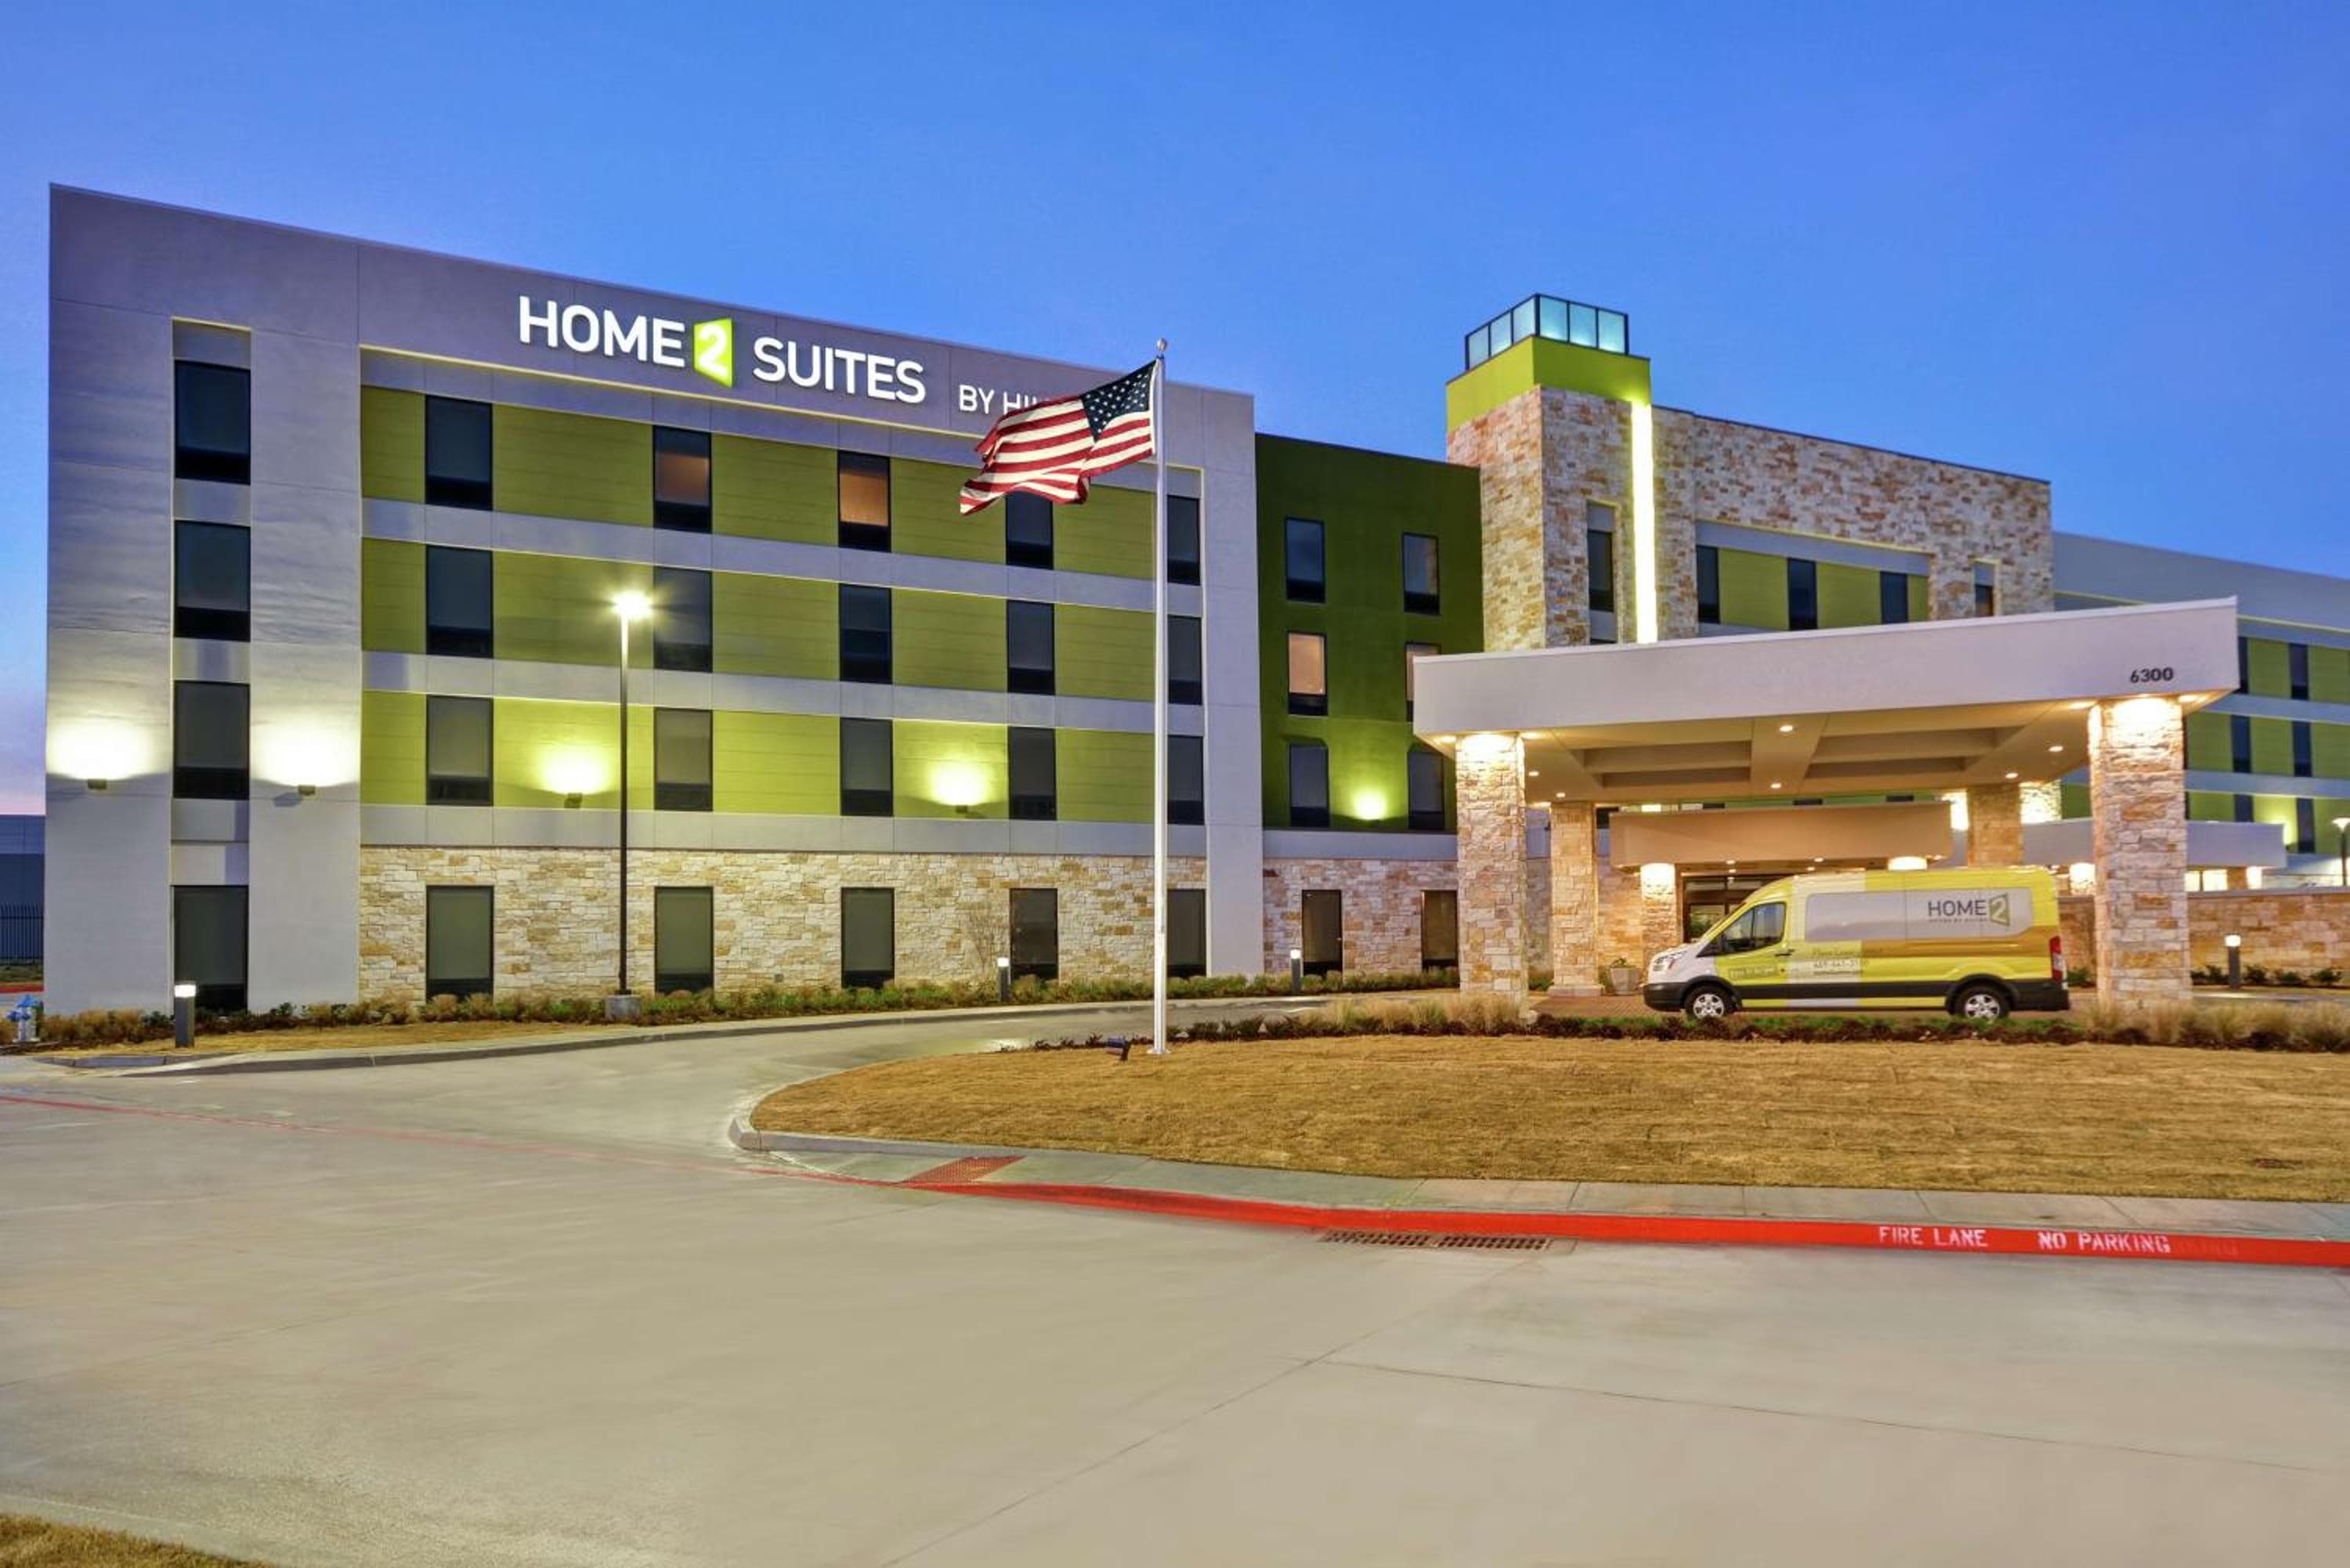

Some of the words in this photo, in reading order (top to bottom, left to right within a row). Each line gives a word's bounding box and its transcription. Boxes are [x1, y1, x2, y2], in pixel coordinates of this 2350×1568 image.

[519, 295, 686, 368] HOME
[699, 322, 730, 380] 2
[753, 336, 927, 404] SUITES
[959, 384, 995, 414] BY
[2130, 667, 2174, 684] 6300
[1928, 900, 1987, 916] HOME
[1880, 1226, 1923, 1245] FIRE
[1933, 1227, 1988, 1247] LANE
[2037, 1231, 2067, 1250] NO
[2078, 1232, 2171, 1253] PARKING
